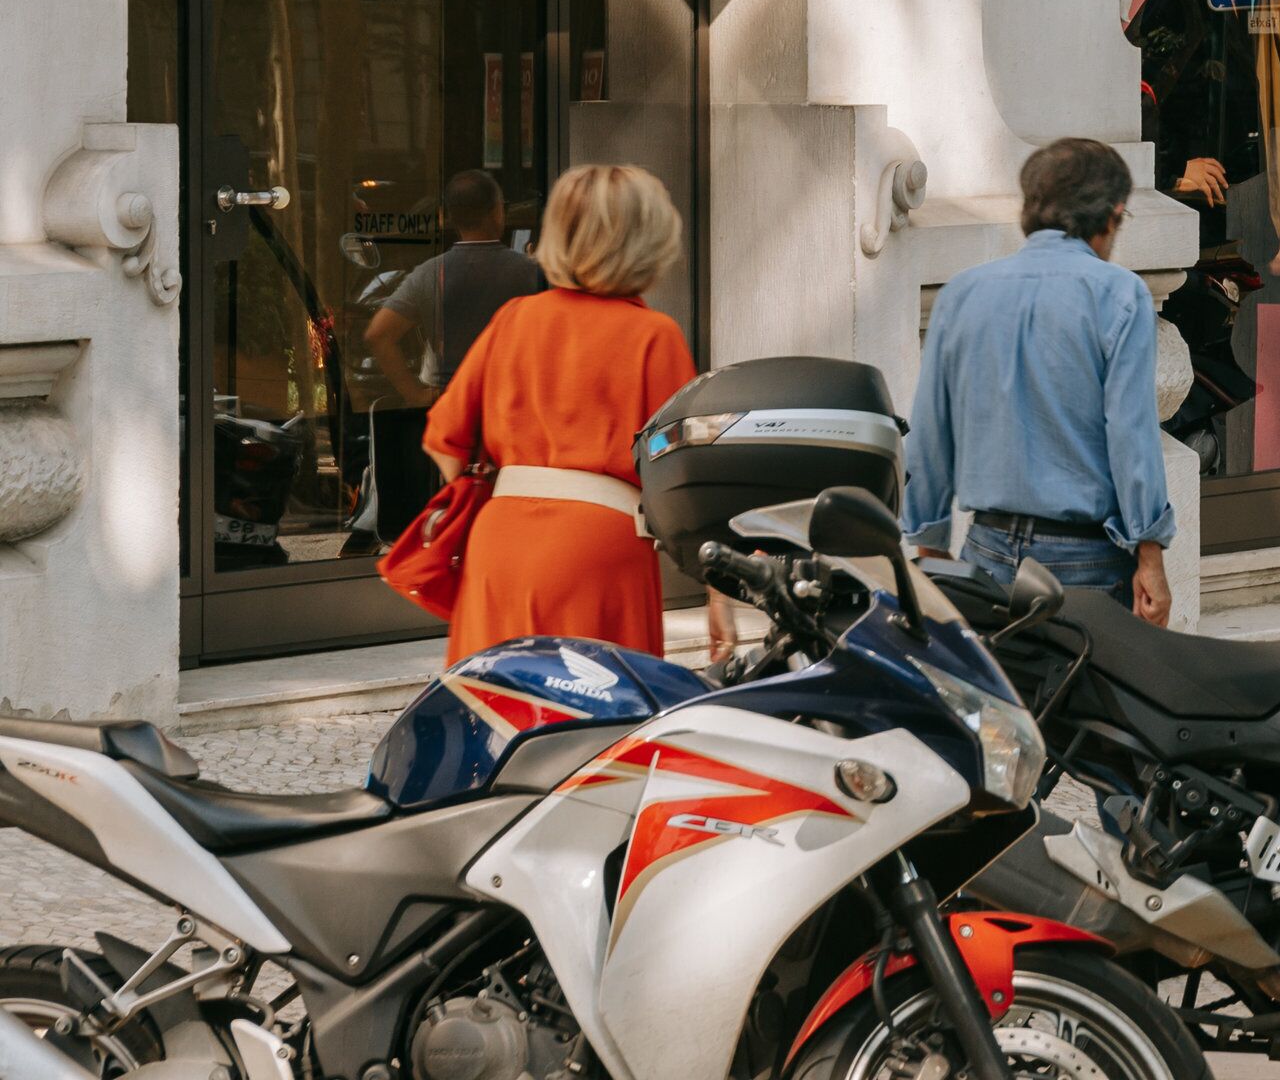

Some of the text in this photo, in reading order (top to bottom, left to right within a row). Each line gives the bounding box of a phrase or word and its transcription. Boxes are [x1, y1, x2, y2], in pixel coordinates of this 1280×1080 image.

[354, 212, 432, 234] STAFF ONLY
[543, 675, 614, 703] HONDA
[666, 813, 786, 848] CBR
